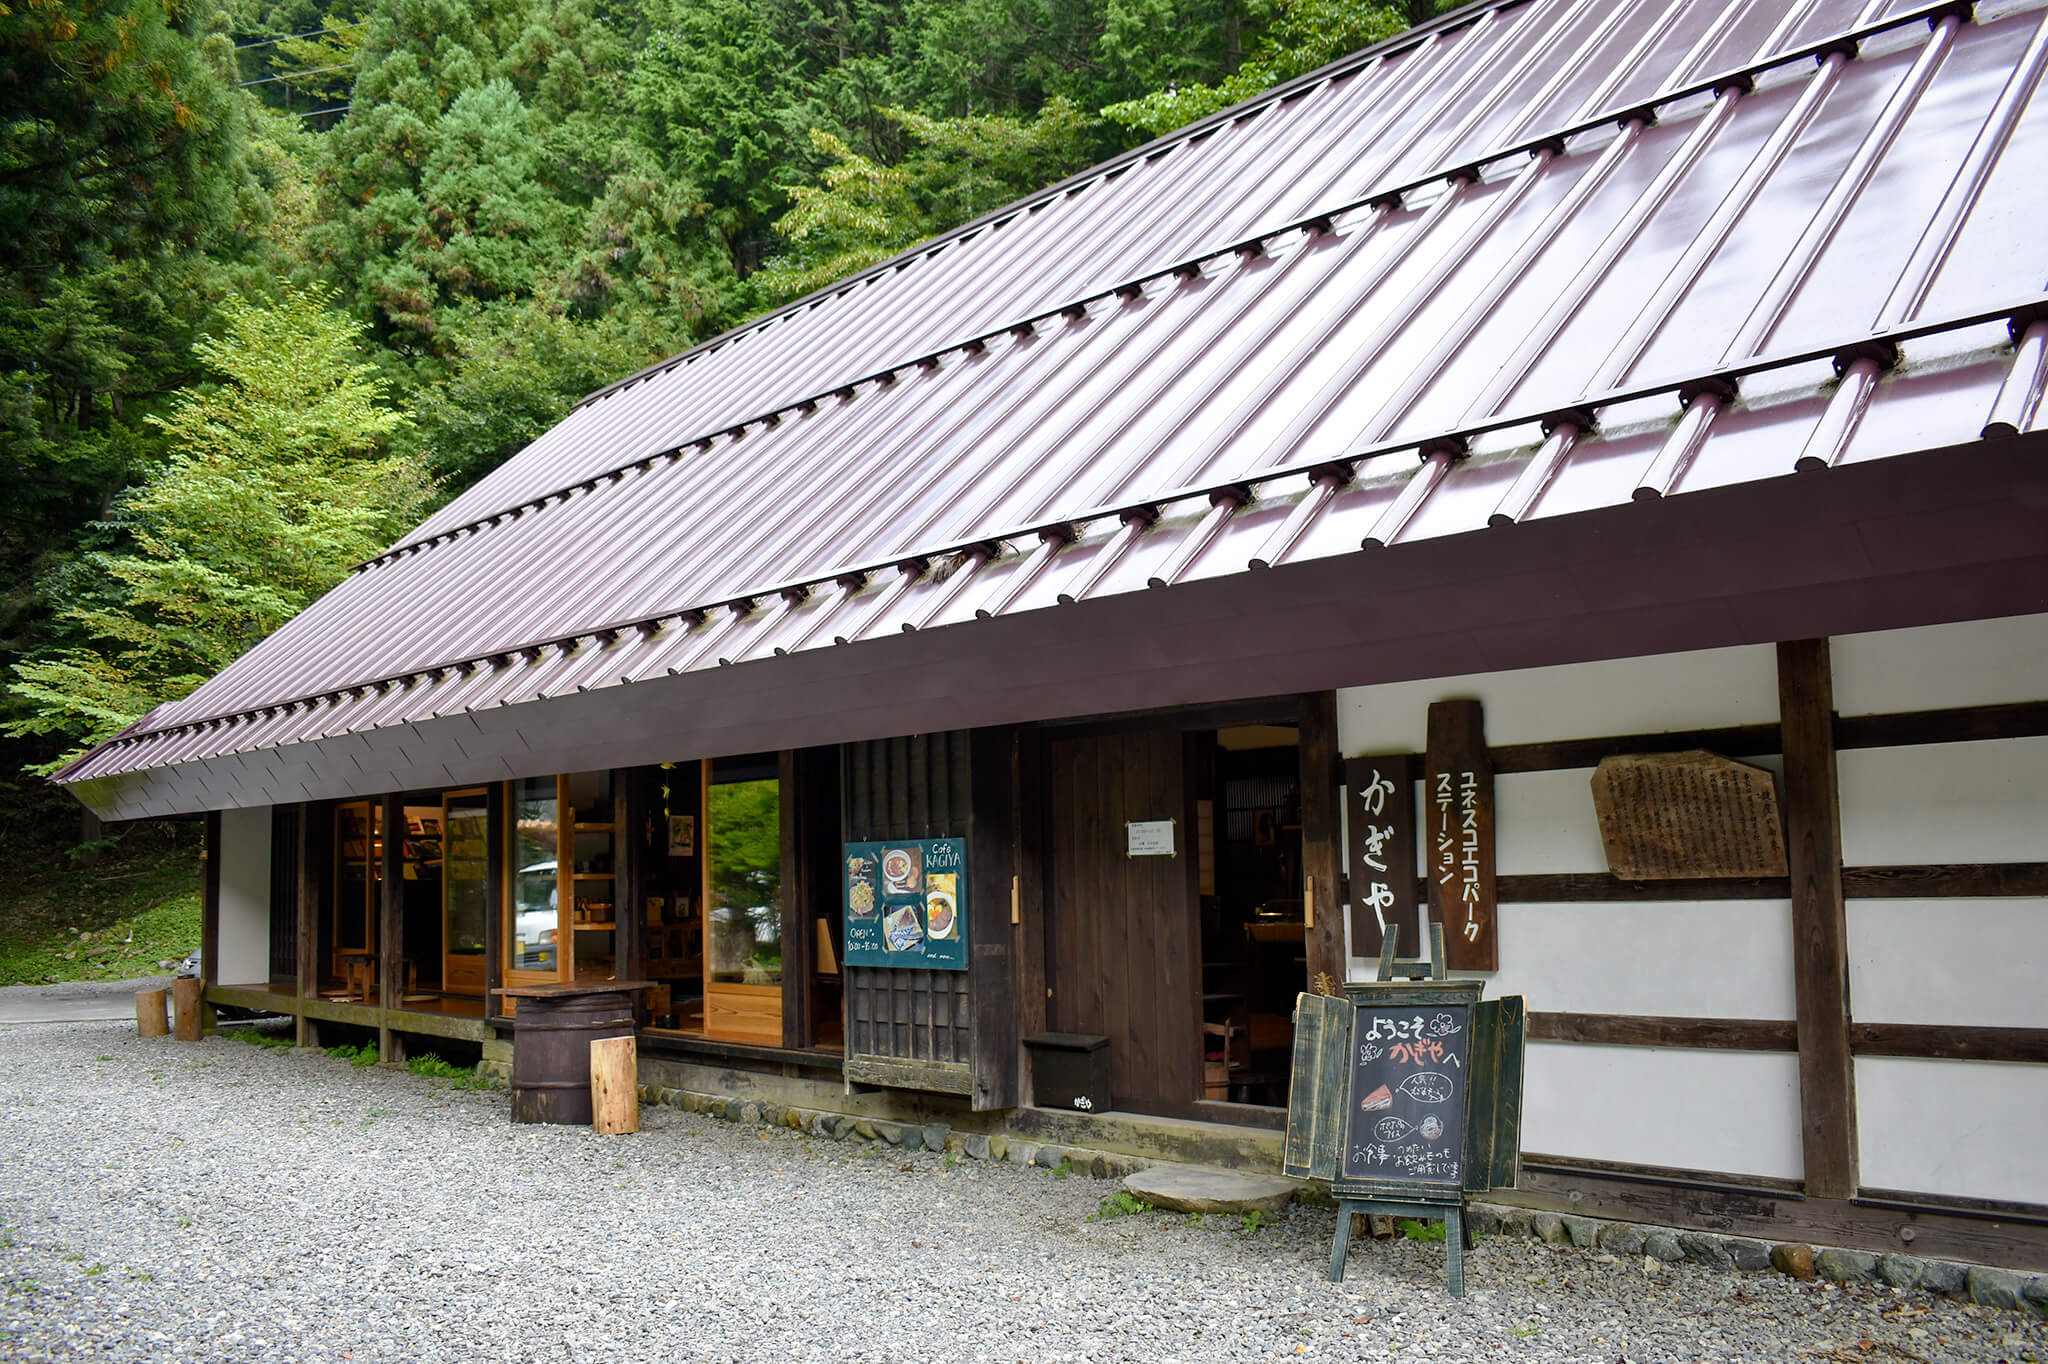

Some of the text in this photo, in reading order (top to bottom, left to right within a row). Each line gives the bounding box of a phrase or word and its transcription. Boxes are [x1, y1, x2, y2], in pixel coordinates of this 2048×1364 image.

[926, 852, 961, 868] KAGIYA
[1360, 769, 1396, 937] かぎや
[1436, 772, 1454, 885] ステーション
[1459, 771, 1481, 942] ユネスコエコパーク
[1366, 1016, 1424, 1040] ようこそ
